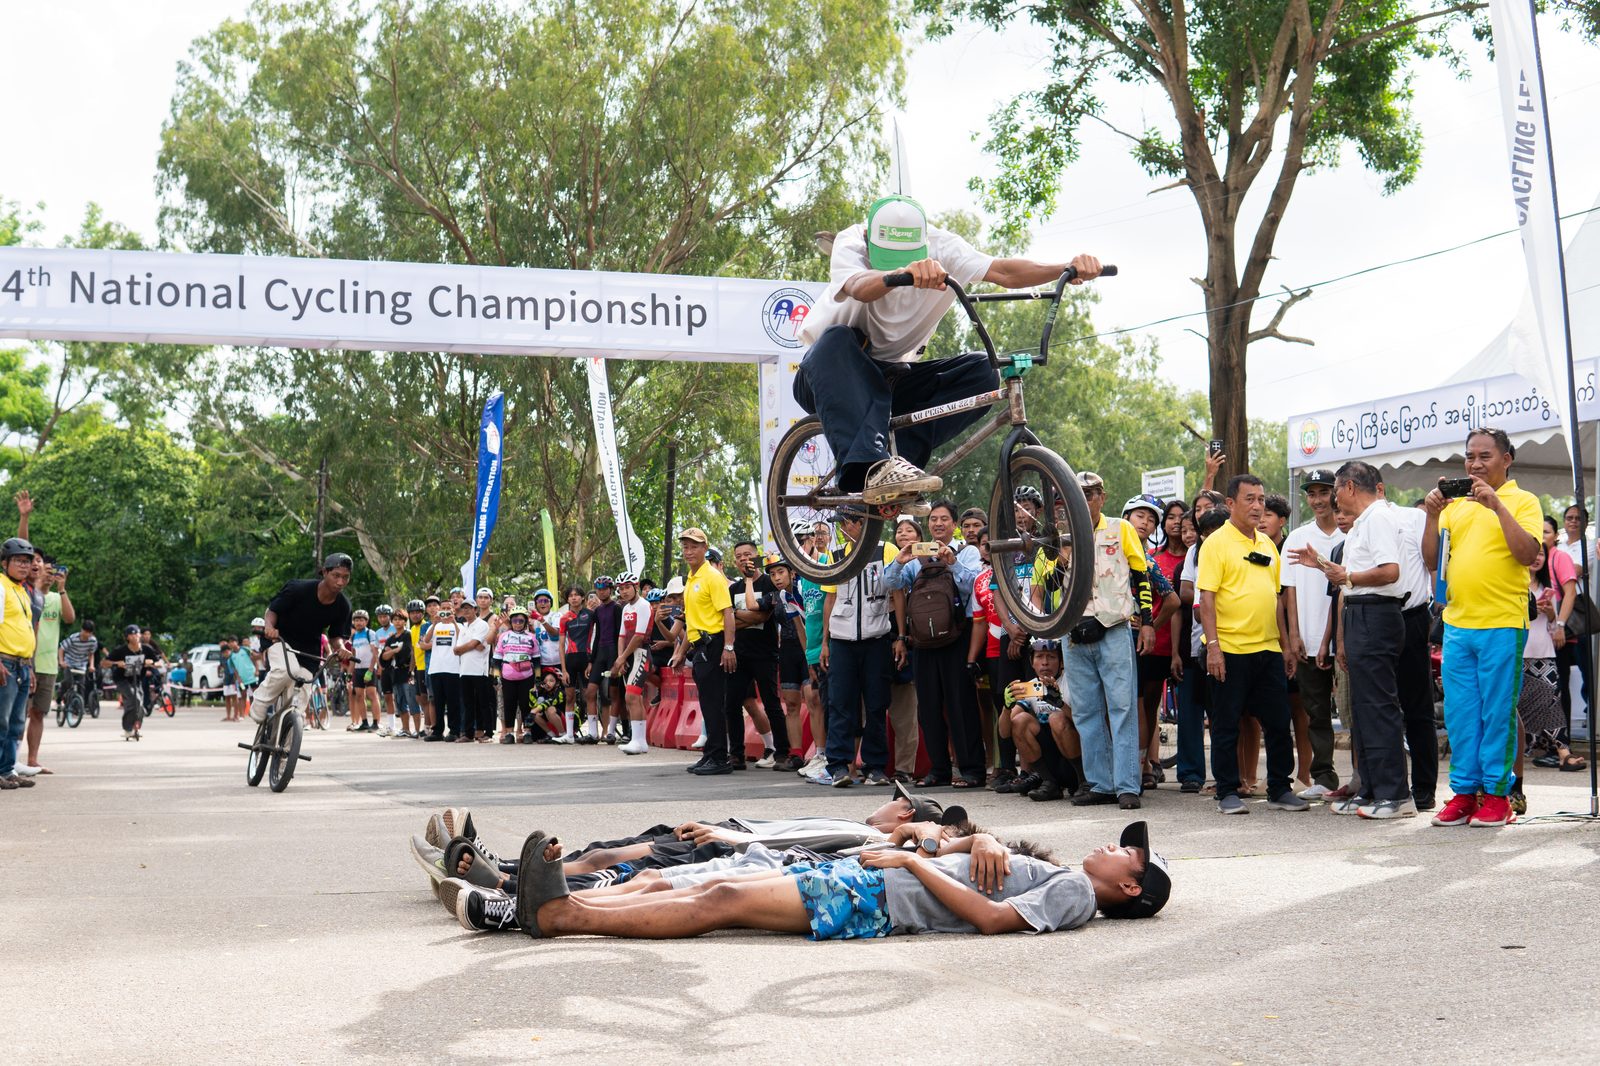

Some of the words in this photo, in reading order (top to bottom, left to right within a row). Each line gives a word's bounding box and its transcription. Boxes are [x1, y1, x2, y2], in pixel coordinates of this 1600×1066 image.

[1, 266, 51, 301] 4th
[70, 271, 246, 310] National
[264, 278, 412, 325] Cycling
[428, 283, 707, 335] Championship
[481, 460, 498, 513] FEDERATION
